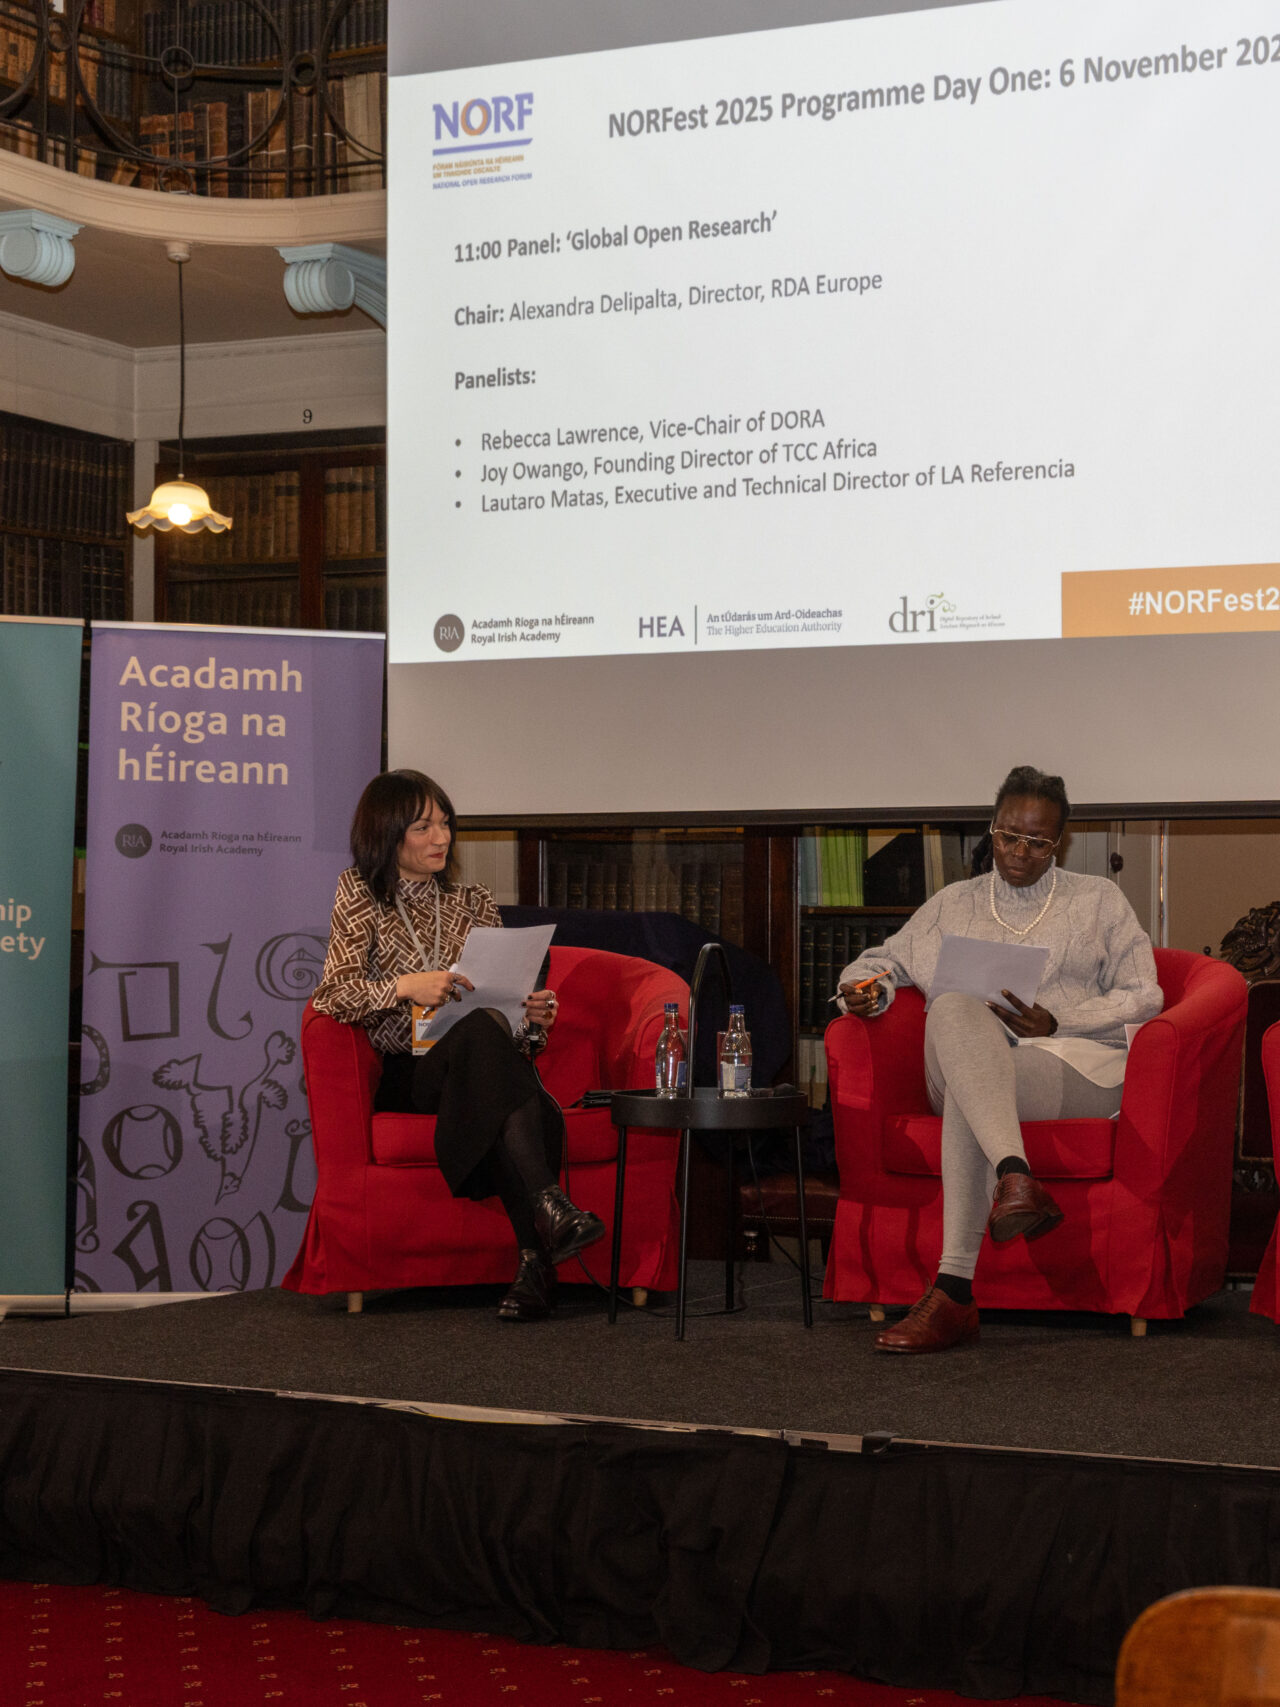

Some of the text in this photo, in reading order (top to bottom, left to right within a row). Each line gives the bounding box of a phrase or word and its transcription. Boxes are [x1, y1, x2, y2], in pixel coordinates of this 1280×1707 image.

[609, 104, 708, 138] NORFest
[716, 95, 773, 126] 2025
[782, 83, 925, 121] Programme
[934, 75, 982, 105] Day
[989, 67, 1050, 95] One:
[1060, 59, 1075, 87] 6
[1084, 45, 1227, 84] November
[432, 92, 533, 140] NORF
[455, 240, 501, 262] 11:00
[508, 233, 560, 257] Panel:
[634, 226, 682, 248] Open
[455, 275, 882, 326] Chair: Alexandra Delipalta, Director, RDA Europe
[455, 367, 535, 390] Panelists:
[302, 408, 312, 424] 9
[482, 409, 825, 451] Rebecca Lawrence, Vice-Chair of DORA
[481, 438, 876, 485] Joy Owango, Founding Director of TCC Africa
[482, 459, 1074, 512] Lautaro Matas, Executive and Technical Director of LA Referencia
[472, 613, 594, 629] Acadamh Ríoga na hÉireann
[639, 616, 685, 638] HEA
[706, 621, 842, 637] The Higher Education Authority
[707, 614, 719, 623] An
[757, 613, 773, 621] um
[774, 608, 842, 620] Ard-Oideachas
[889, 596, 937, 633] dri
[471, 631, 560, 646] Royal Irish Academy
[119, 655, 303, 693] Acadamh
[120, 701, 287, 743] Ríoga na
[118, 744, 289, 785] hÉireann
[160, 844, 263, 856] Royal Irish Academy
[161, 831, 208, 840] Acadamh
[257, 833, 302, 843] hÉireann
